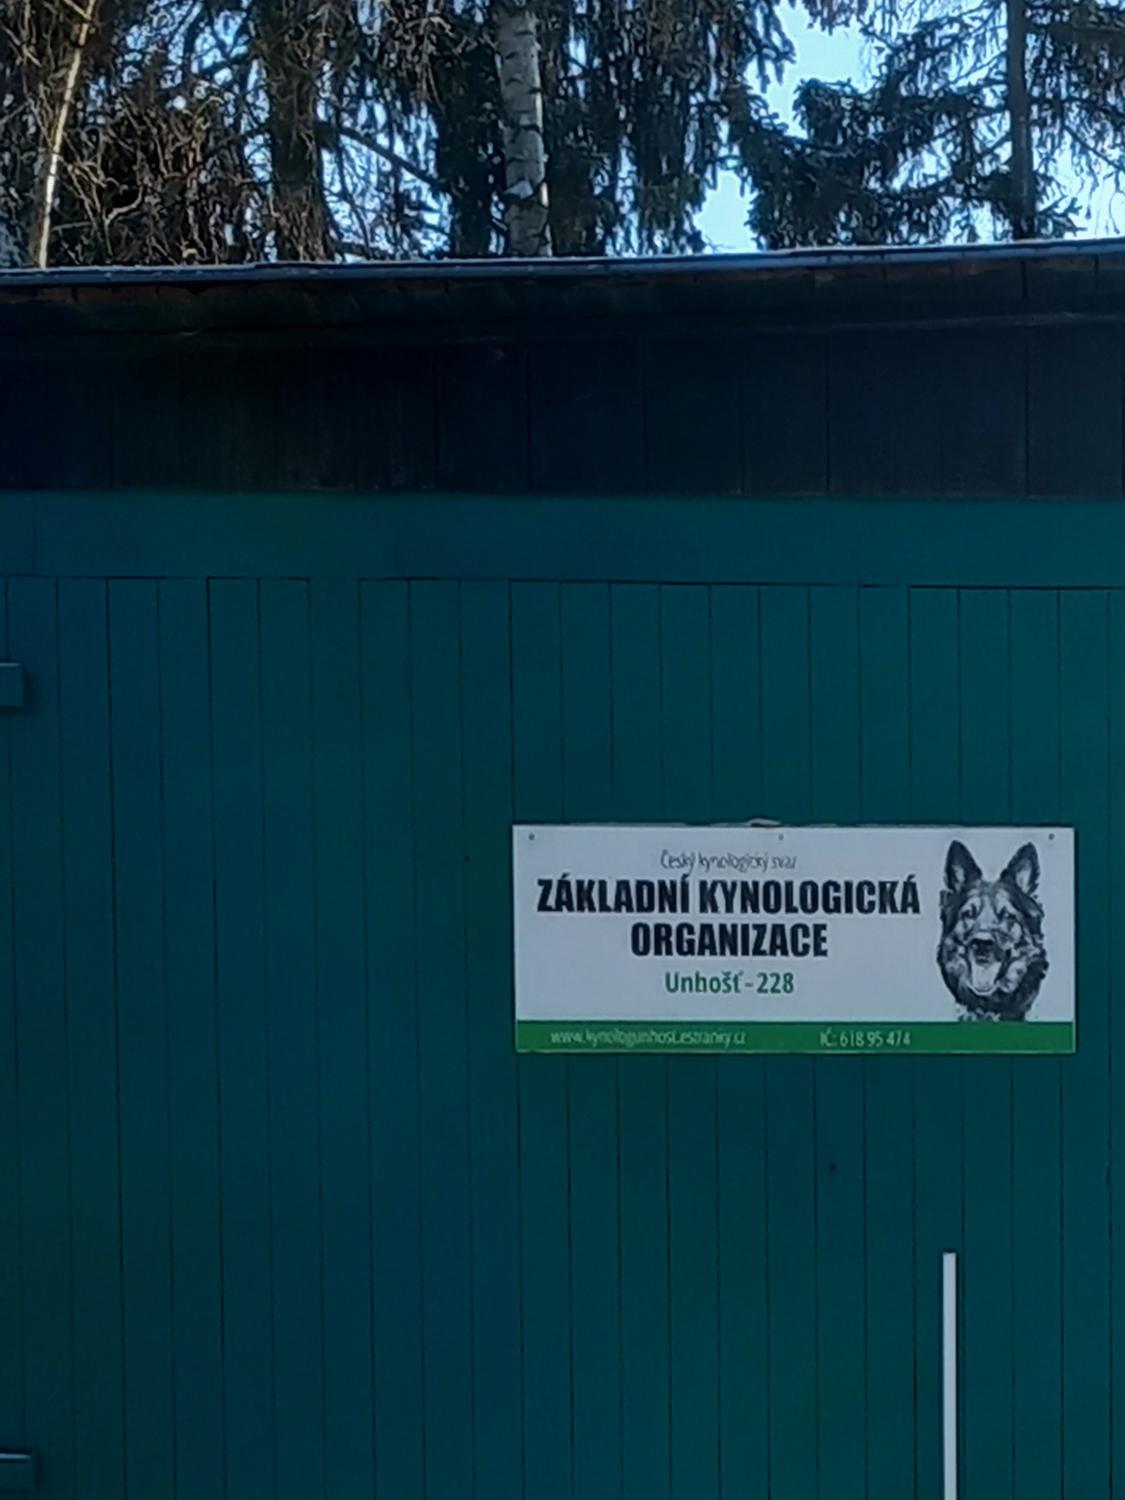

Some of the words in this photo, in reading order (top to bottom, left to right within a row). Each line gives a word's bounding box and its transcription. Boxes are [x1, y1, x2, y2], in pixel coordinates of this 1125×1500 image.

[536, 873, 690, 913] ZÁKLADNÍ
[699, 874, 921, 914] KYNOLOGICKÁ
[630, 922, 829, 957] ORGANIZACE
[664, 969, 744, 993] Unhošť
[756, 971, 795, 994] 228
